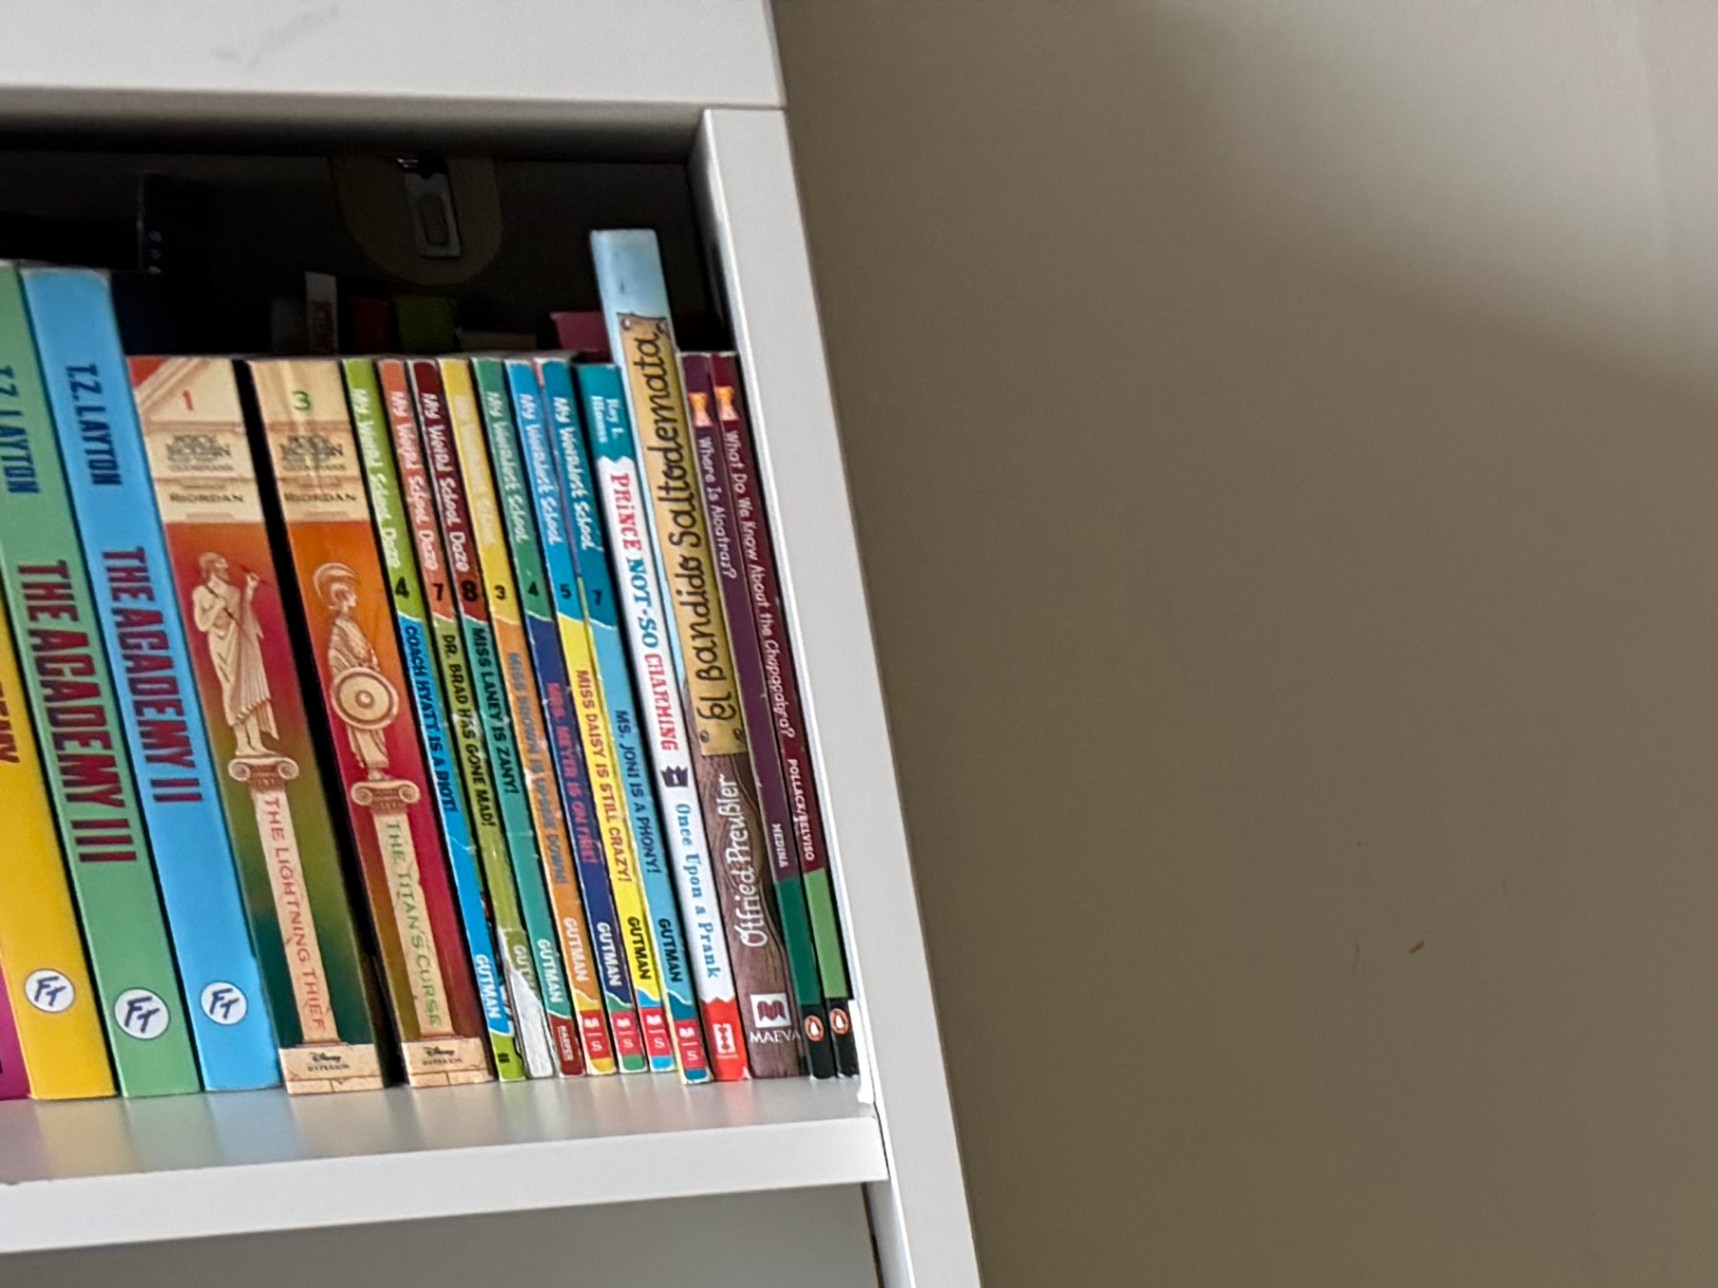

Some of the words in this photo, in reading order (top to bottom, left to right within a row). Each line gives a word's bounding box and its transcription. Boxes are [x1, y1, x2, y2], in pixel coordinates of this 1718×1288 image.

[292, 390, 311, 411] 3
[75, 404, 121, 485] LAYTON
[634, 332, 701, 548] Saltodemata
[574, 503, 597, 550] School
[699, 436, 716, 483] Where
[711, 504, 737, 579] Alcatraz?
[102, 546, 155, 603] THE
[449, 531, 469, 572] Daze
[18, 559, 79, 623] THE
[395, 578, 410, 598] 4
[460, 580, 478, 599] 8
[559, 584, 572, 599] 5
[610, 473, 642, 550] PRINCE
[627, 558, 659, 648] NOT-SO
[644, 653, 679, 751] CHARMING
[725, 431, 740, 470] What
[742, 521, 758, 562] Know
[764, 637, 795, 738] Chupacabra?
[675, 555, 726, 680] Bandido
[111, 606, 196, 769] ACADEMY
[404, 625, 428, 673] COACH
[416, 674, 438, 732] HYATT
[576, 670, 595, 711] MISS
[29, 629, 125, 808] ACADEMY
[471, 628, 489, 671] MISS
[483, 670, 502, 723] LANEY
[495, 746, 519, 795] ZANY!
[585, 712, 606, 759] DAISY
[448, 663, 467, 711] BRAD
[464, 745, 485, 786] GONE
[475, 787, 496, 827] MAD!
[150, 778, 203, 803] II
[599, 781, 621, 824] STILL
[71, 818, 137, 862] III
[386, 820, 410, 864] THE
[608, 826, 632, 883] CRAZY!
[636, 816, 661, 873] PHONY!
[773, 824, 789, 868] MEDINA
[262, 797, 285, 840] THE
[275, 844, 311, 962] LIGHTNING
[301, 963, 327, 1031] THIEF
[397, 869, 426, 947] TITAN'S
[676, 803, 692, 846] Once
[685, 852, 704, 901] Upon
[697, 920, 718, 978] Prank
[537, 939, 562, 1003] GUTMAN
[563, 918, 589, 983] GUTMAN
[597, 922, 622, 988] GUTMAN
[627, 917, 652, 981] GUTMAN
[658, 918, 684, 982] GUTMAN
[413, 948, 441, 1027] CURSE
[474, 954, 502, 1019] GUTMAN
[750, 1031, 800, 1043] MAEVA
